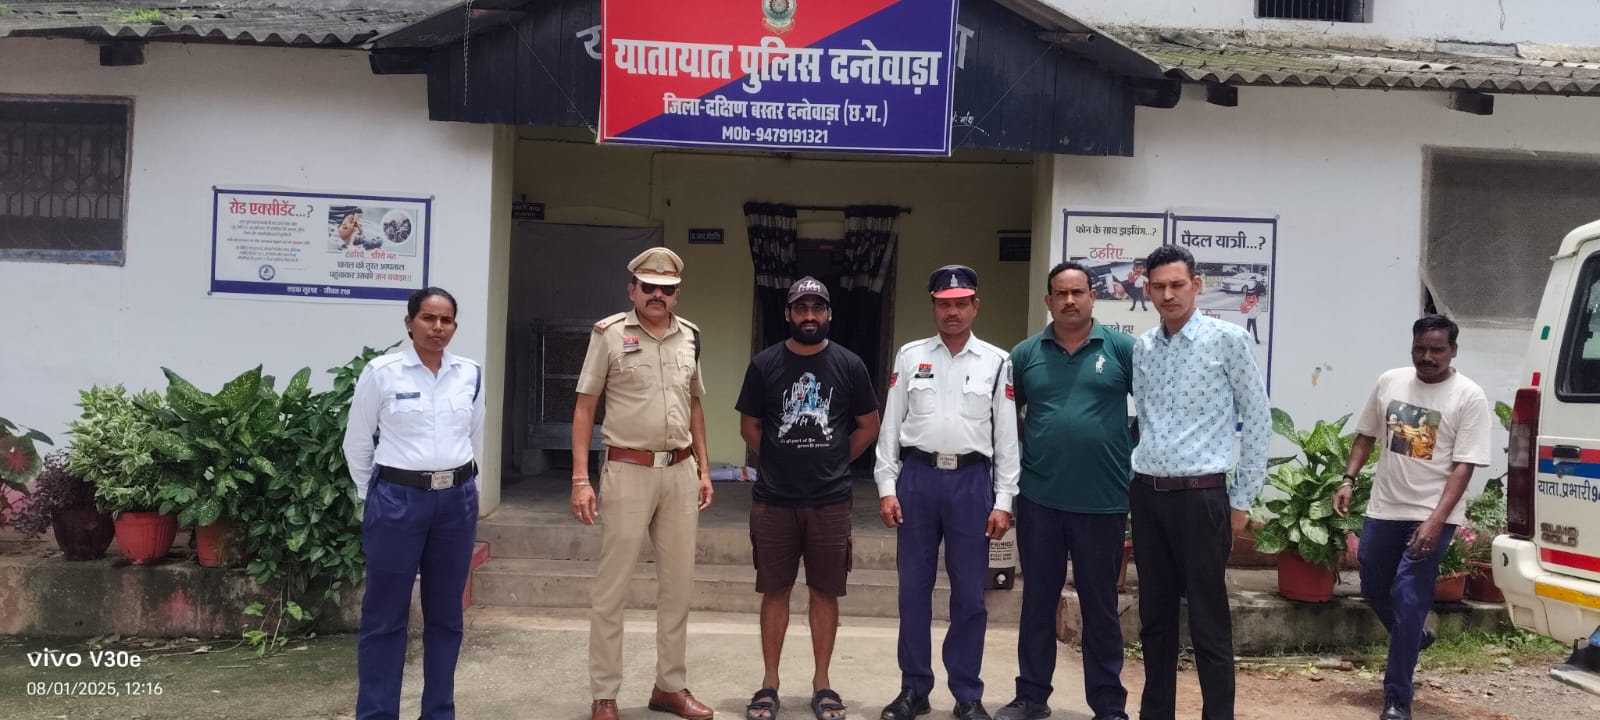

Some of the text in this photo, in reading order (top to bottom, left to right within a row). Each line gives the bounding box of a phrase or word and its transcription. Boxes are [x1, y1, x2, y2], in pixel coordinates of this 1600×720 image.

[612, 38, 733, 79] यातायात
[738, 36, 825, 94] पुलिस
[828, 40, 942, 95] दन्तेवाड़ा
[663, 92, 888, 127] जिला-दक्षिण बस्तर दन्तेवाड़ा (छ.ग.)
[229, 198, 246, 214] रोड
[1075, 223, 1091, 234] फोन
[1092, 223, 1102, 234] के
[1103, 226, 1118, 235] साथ
[1181, 229, 1212, 248] पैदल
